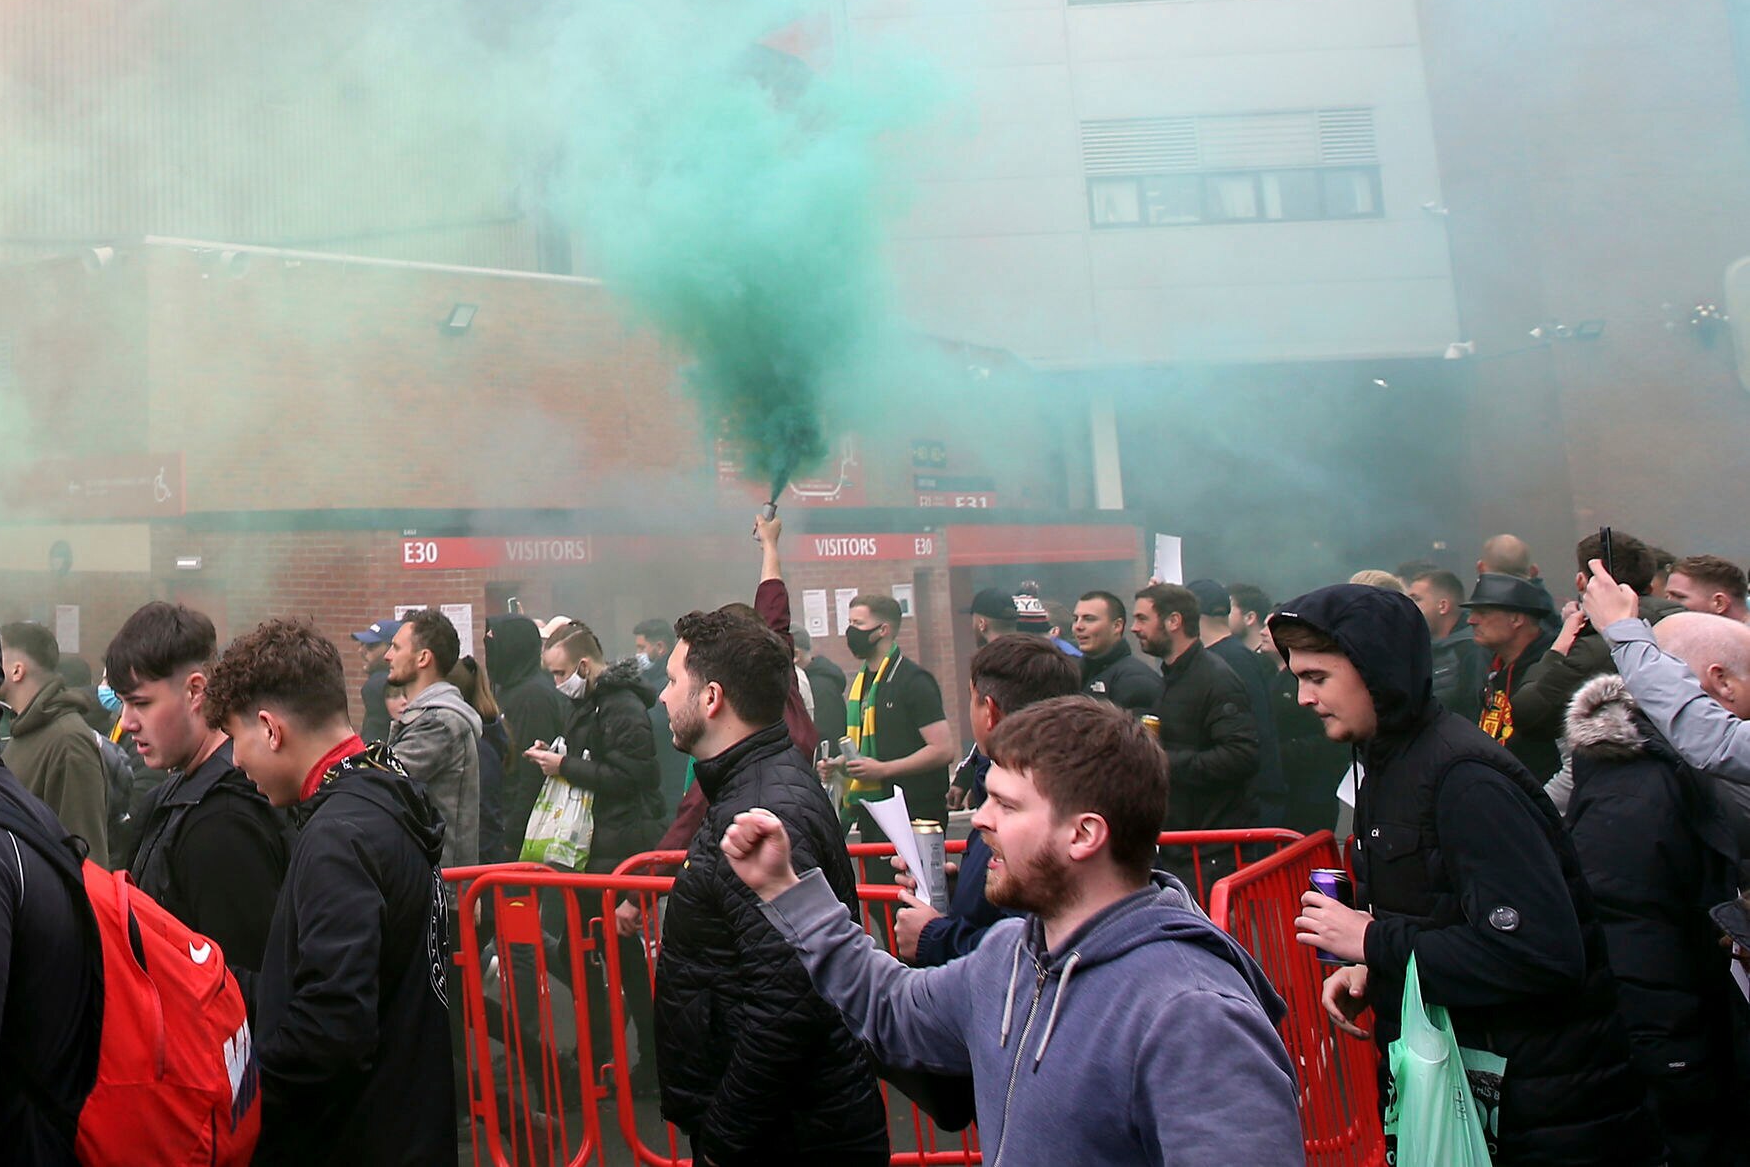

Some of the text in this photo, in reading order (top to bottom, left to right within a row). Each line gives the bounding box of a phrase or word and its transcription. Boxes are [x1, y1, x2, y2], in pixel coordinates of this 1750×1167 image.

[403, 539, 586, 564] E30 VISITORS
[815, 538, 932, 556] VISITORS E30
